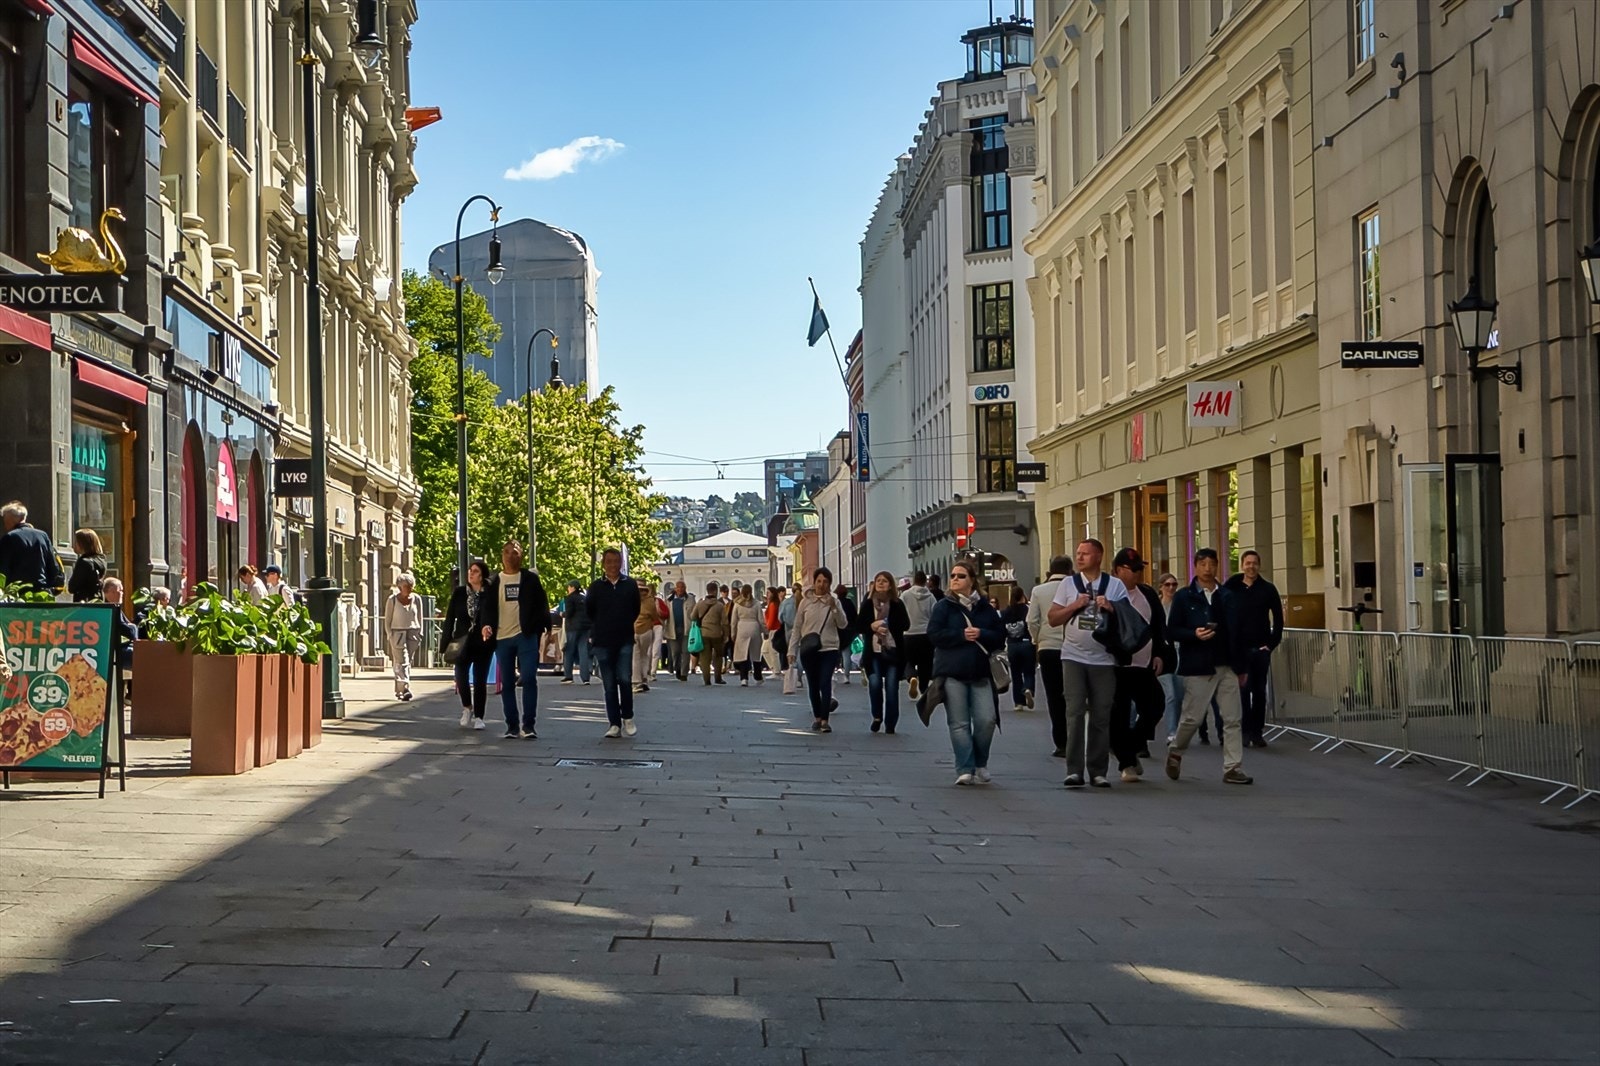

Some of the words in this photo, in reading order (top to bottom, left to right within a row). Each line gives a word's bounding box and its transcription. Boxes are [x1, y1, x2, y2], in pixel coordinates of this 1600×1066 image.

[0, 286, 104, 304] ENOTECA
[1342, 350, 1419, 360] CARLINGS
[1193, 390, 1233, 417] H&M
[74, 433, 106, 471] RADIS
[7, 620, 100, 645] SLICES
